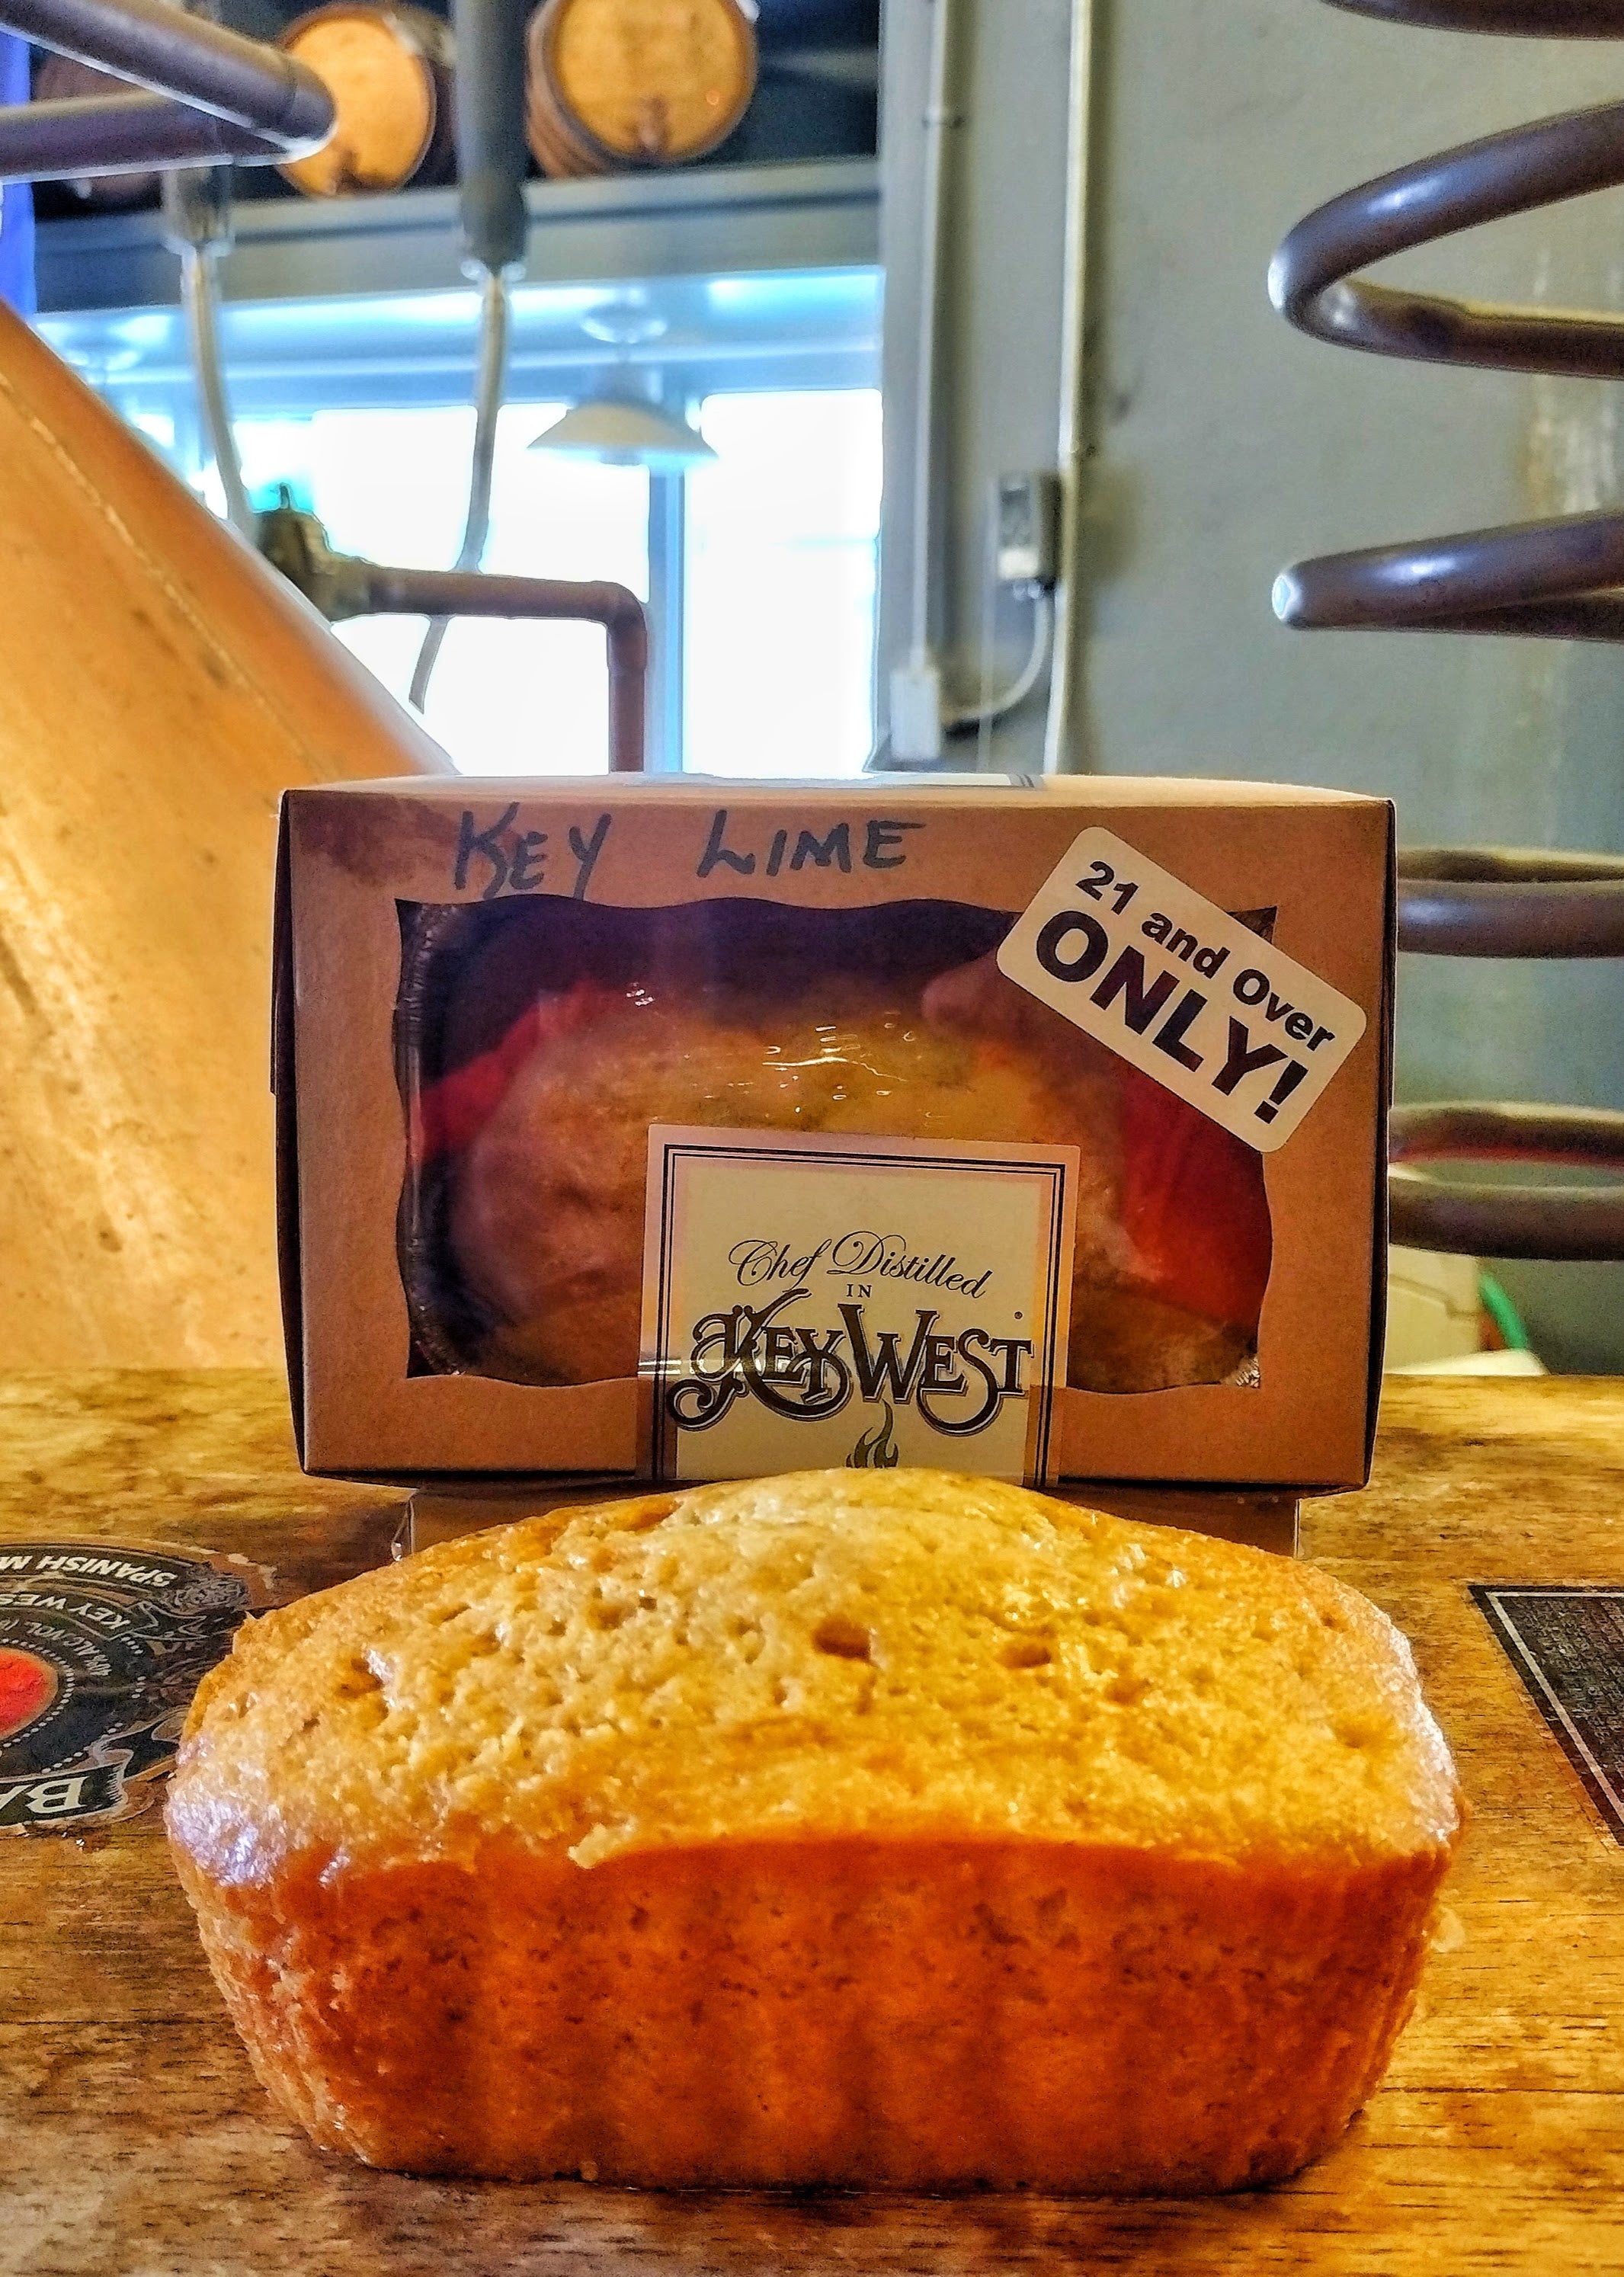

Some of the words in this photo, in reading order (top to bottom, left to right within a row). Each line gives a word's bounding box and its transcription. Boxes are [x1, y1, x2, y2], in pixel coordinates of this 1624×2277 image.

[453, 802, 612, 900] KEY
[697, 809, 927, 879] LIME
[1075, 860, 1139, 915] 21
[1142, 912, 1231, 978] and
[1232, 969, 1335, 1052] Over
[1036, 910, 1309, 1125] ONLY!
[728, 1238, 832, 1291] Chef
[826, 1230, 993, 1299] Distilled
[846, 1283, 872, 1299] IN
[36, 1555, 178, 1587] SPANISH
[68, 1603, 131, 1630] KEY
